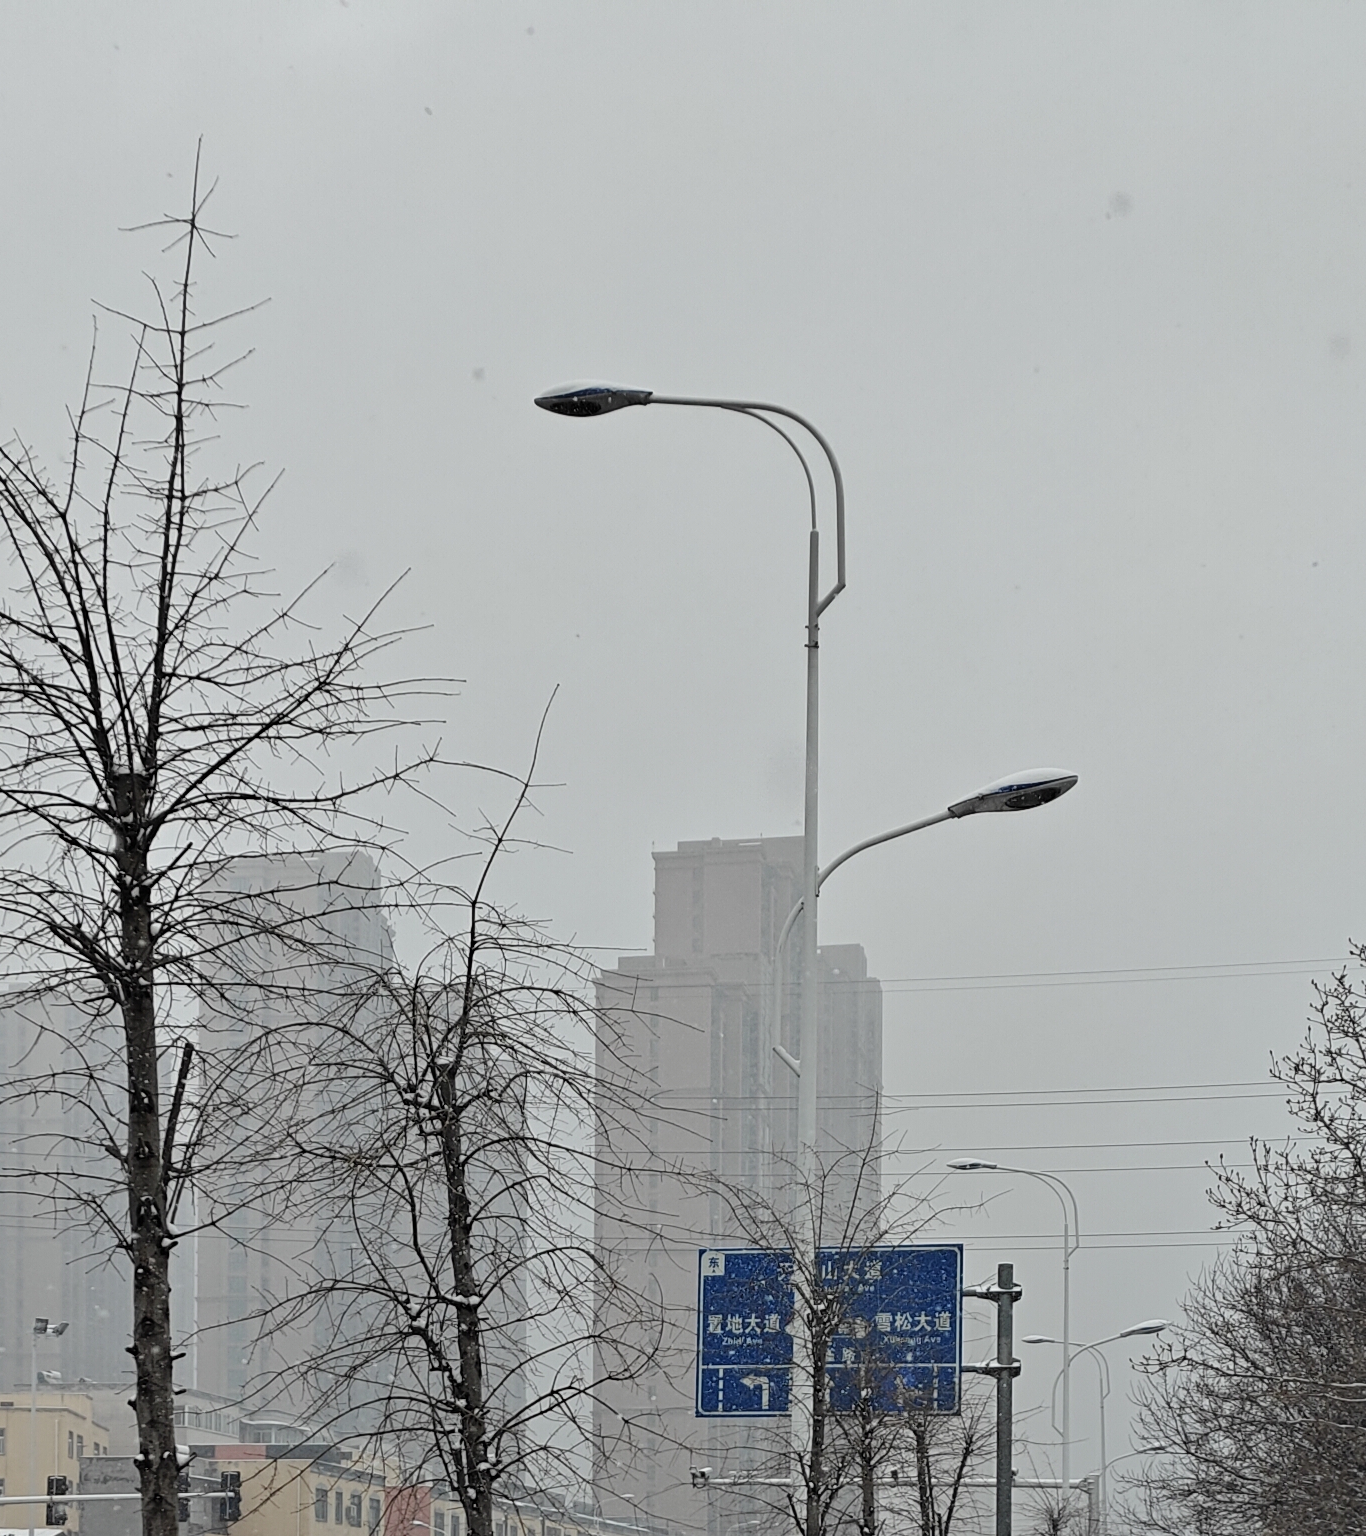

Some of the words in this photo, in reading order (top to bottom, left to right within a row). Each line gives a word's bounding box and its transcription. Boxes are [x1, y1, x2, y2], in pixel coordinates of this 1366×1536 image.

[708, 1257, 720, 1268] 东
[707, 1313, 782, 1335] 置地大道
[875, 1311, 952, 1332] 雪松大道
